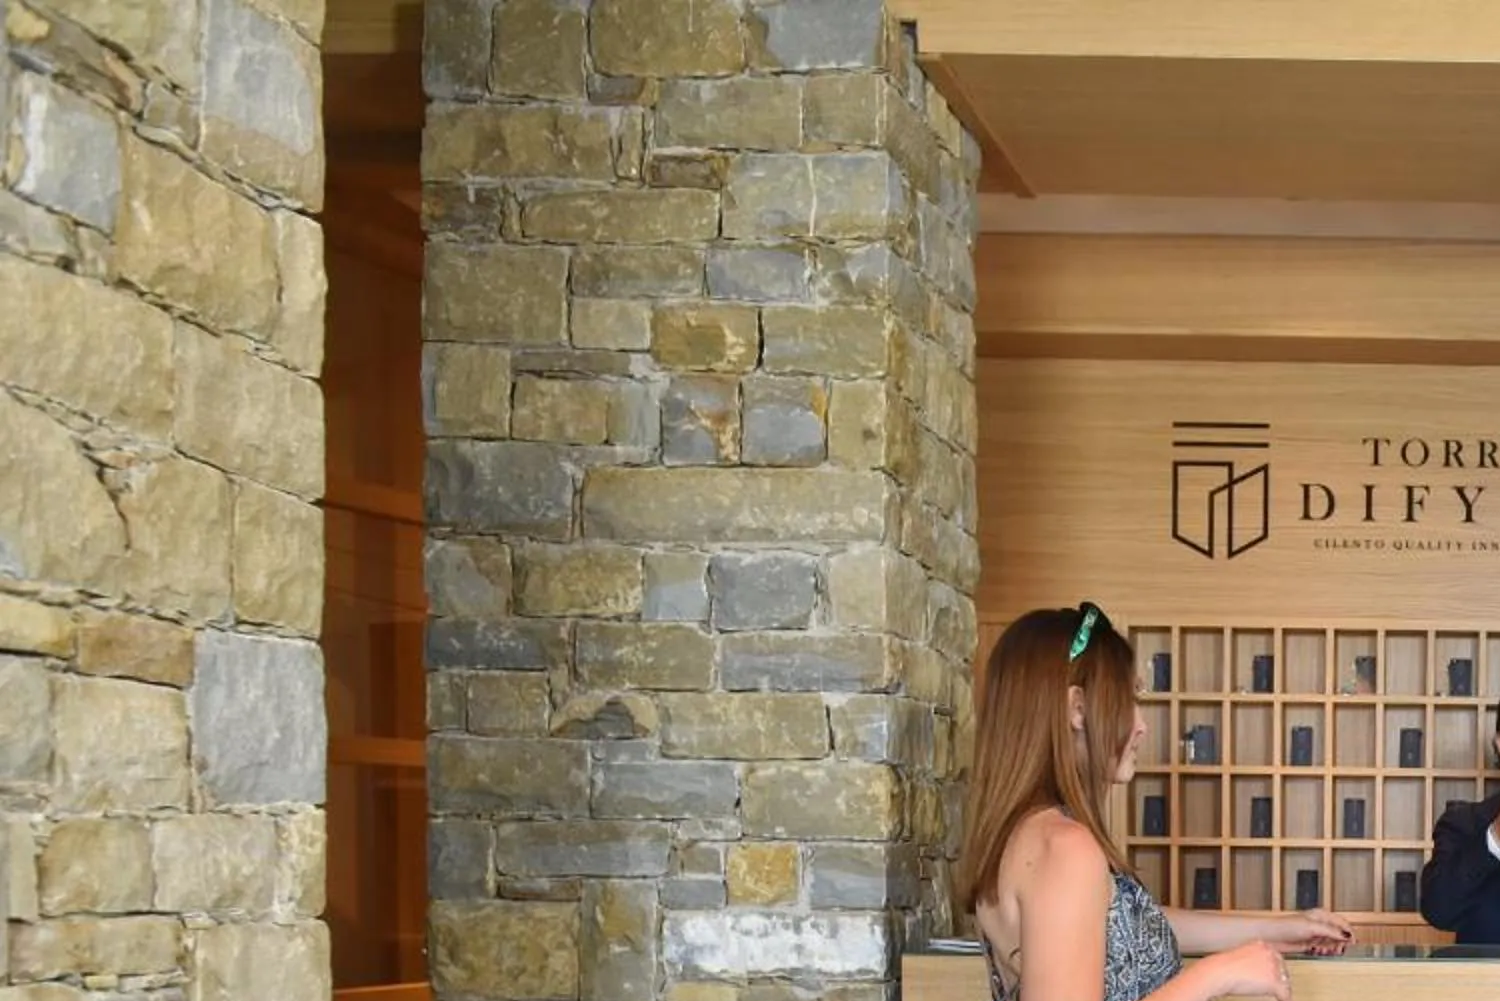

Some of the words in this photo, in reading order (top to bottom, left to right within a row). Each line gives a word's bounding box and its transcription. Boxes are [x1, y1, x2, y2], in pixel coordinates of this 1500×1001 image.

[1313, 538, 1386, 550] CILENTO
[1393, 540, 1463, 551] QUALITY
[1472, 541, 1500, 551] INN
